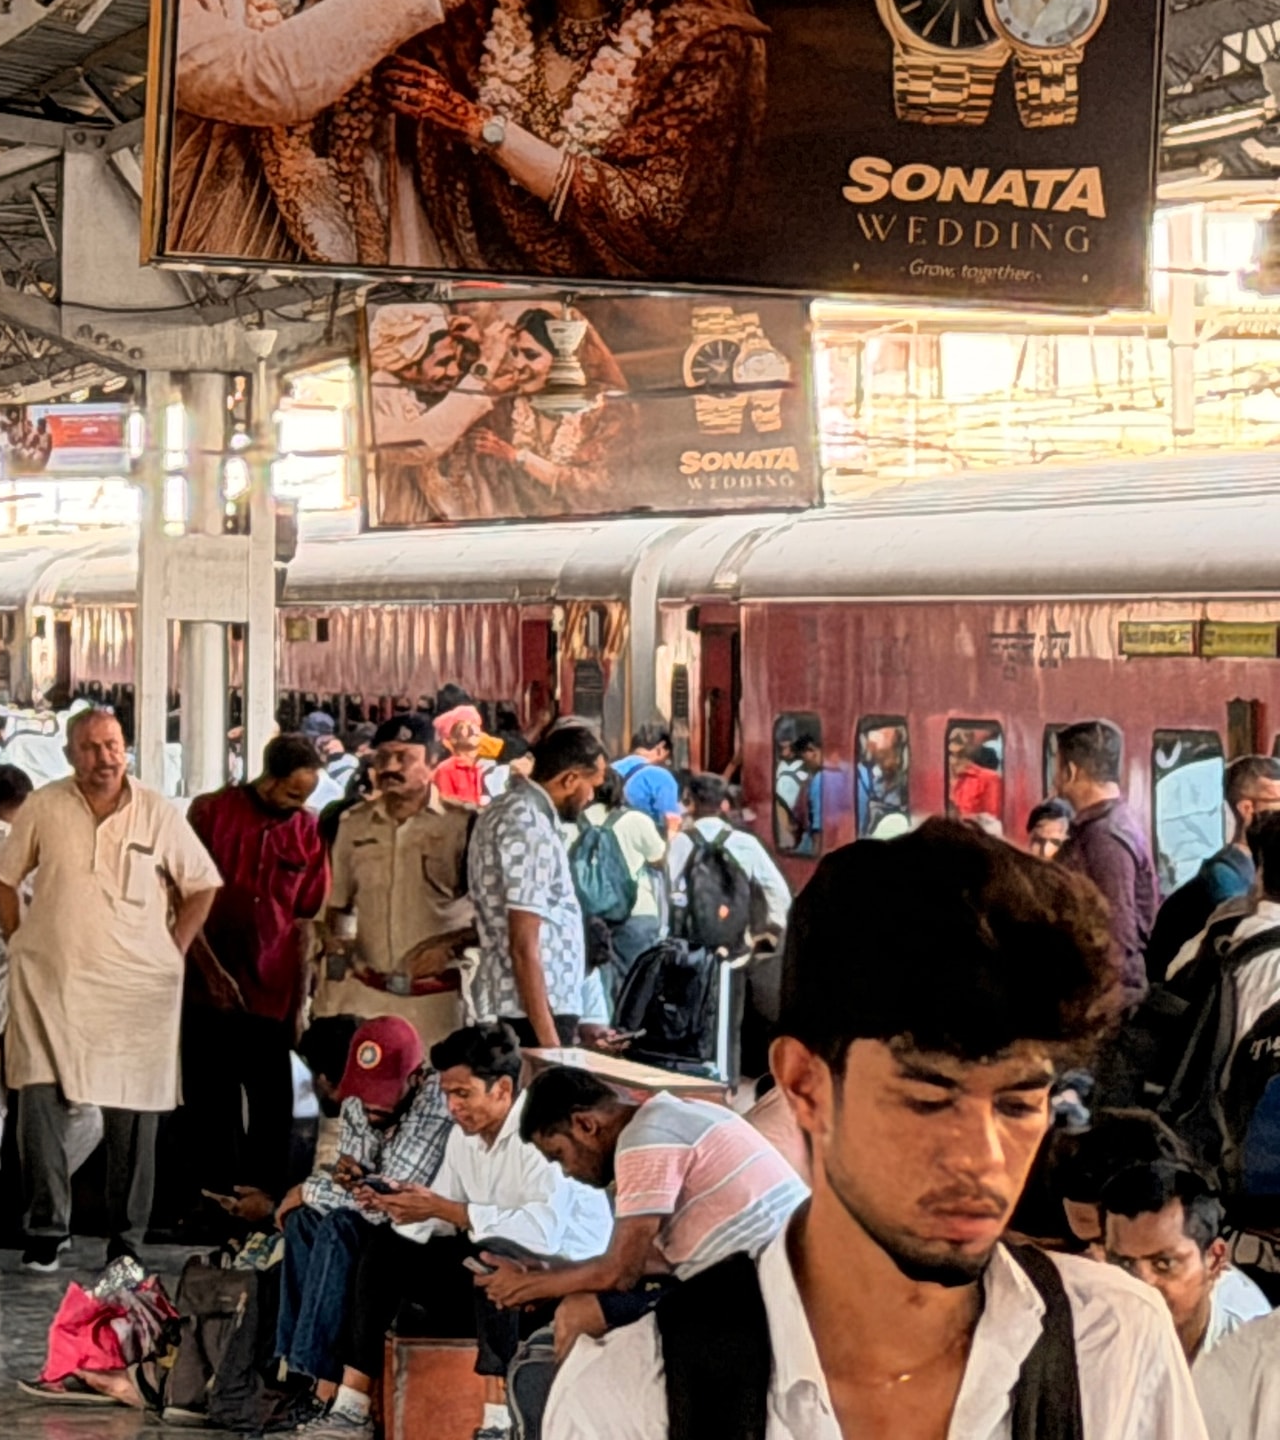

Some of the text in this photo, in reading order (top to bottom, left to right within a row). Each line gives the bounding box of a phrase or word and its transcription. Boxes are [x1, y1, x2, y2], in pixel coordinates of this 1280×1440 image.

[842, 156, 1107, 218] SONATA
[857, 213, 1091, 253] WEDDING
[679, 446, 801, 475] SONATA
[687, 474, 796, 490] WEDDING
